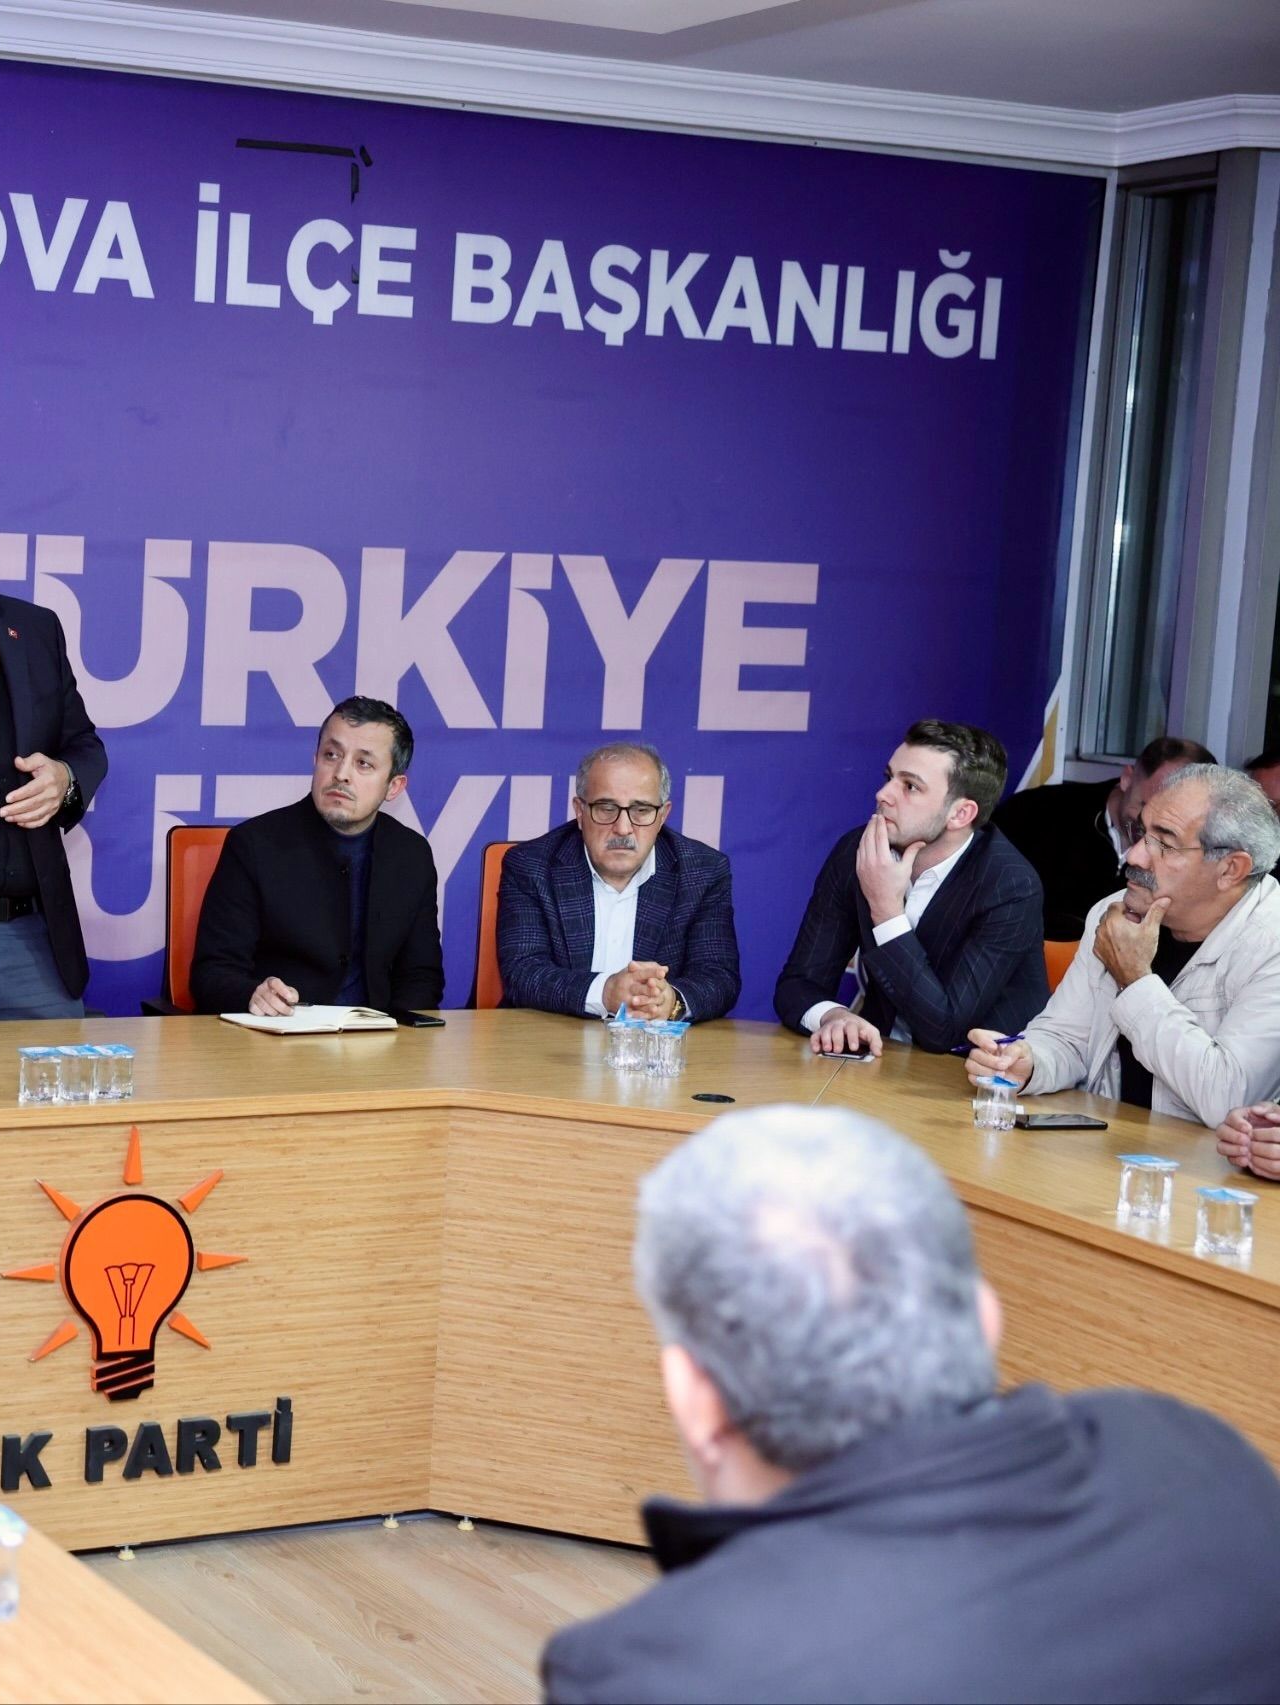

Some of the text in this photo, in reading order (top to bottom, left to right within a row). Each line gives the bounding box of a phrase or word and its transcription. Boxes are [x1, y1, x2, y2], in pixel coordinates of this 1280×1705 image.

[194, 182, 417, 325] İLÇE
[451, 231, 1003, 360] BAŞKANLIĞI
[84, 1396, 294, 1484] PARTİ
